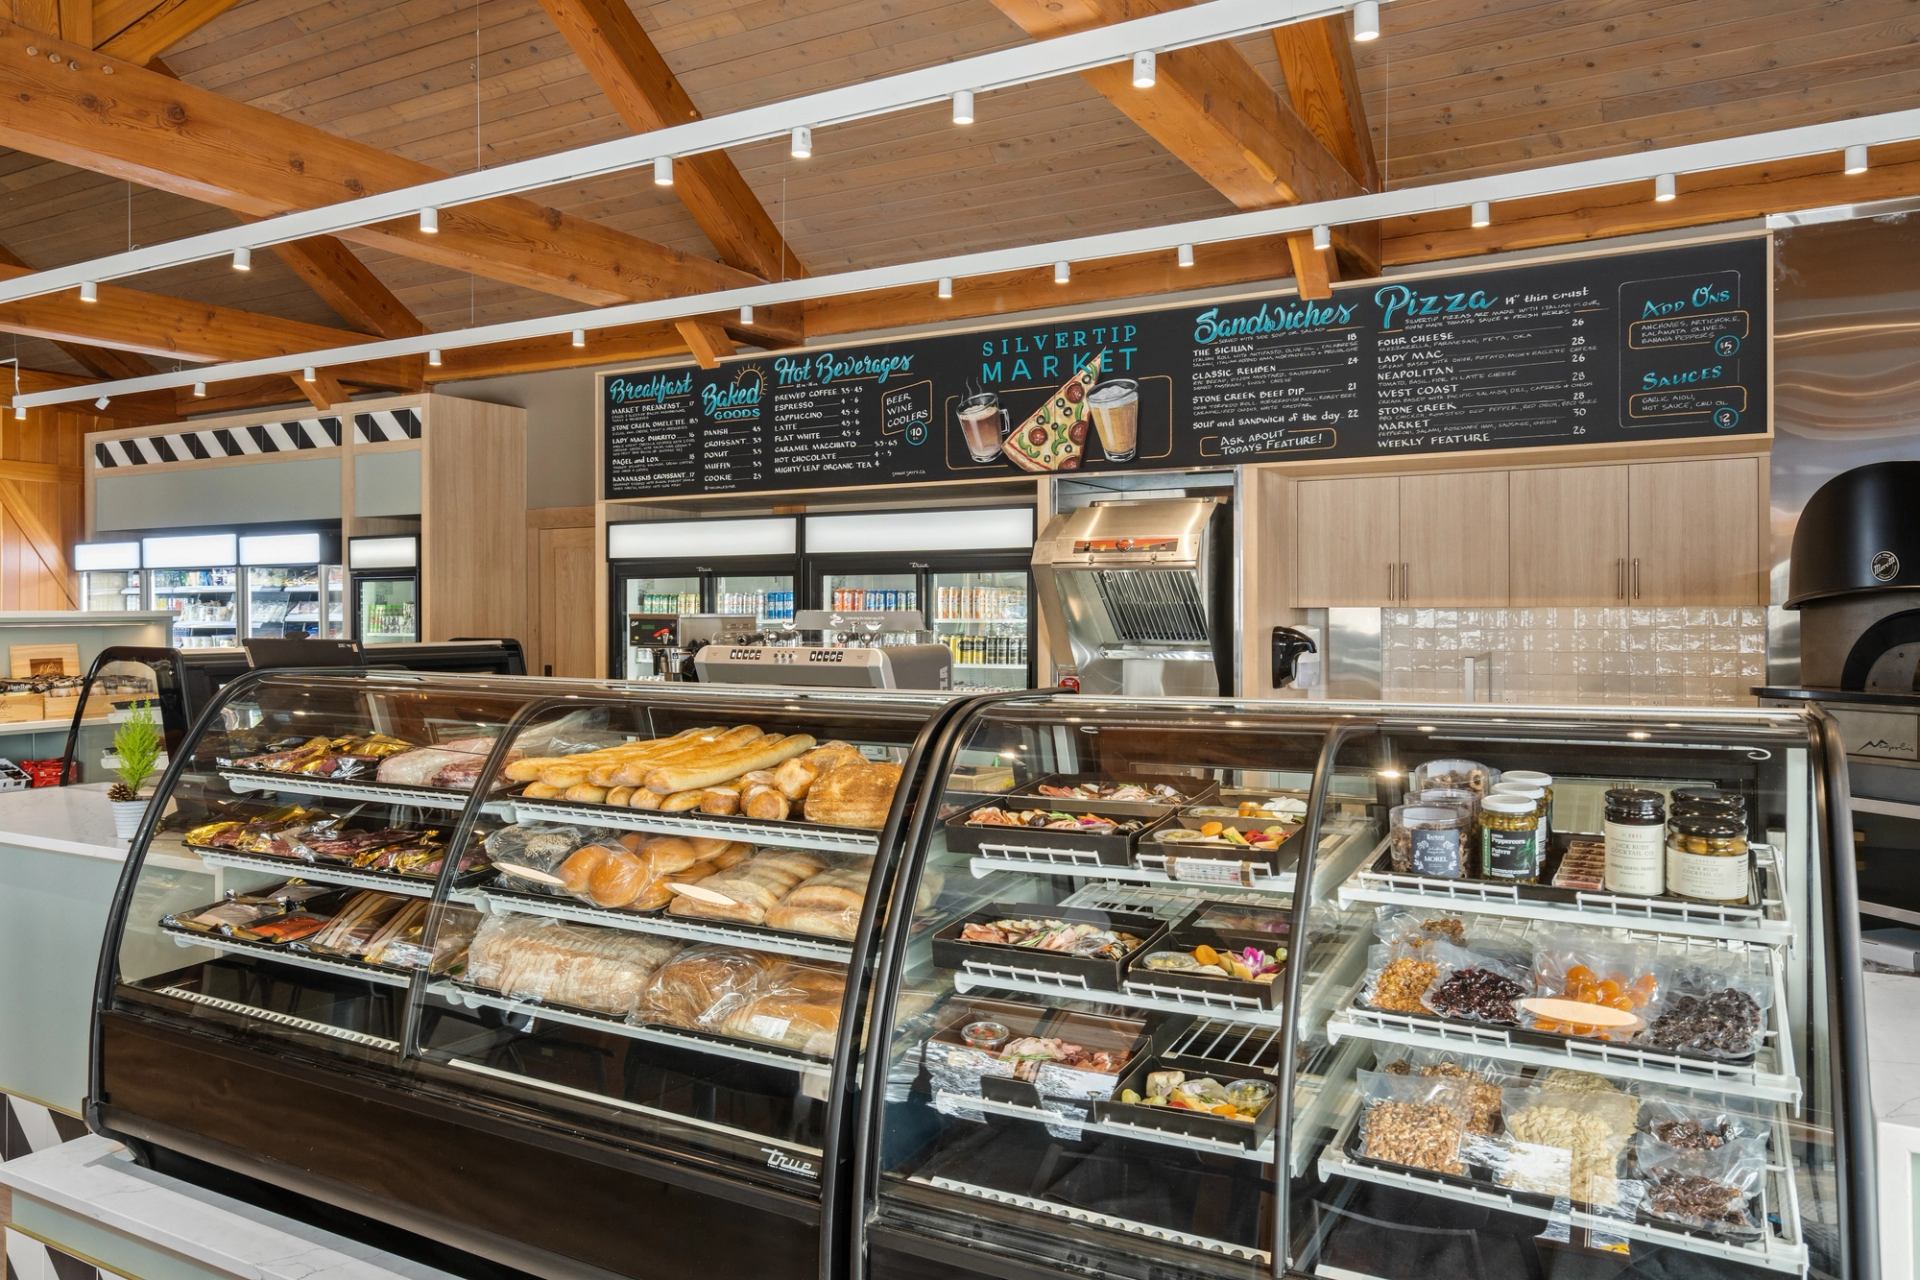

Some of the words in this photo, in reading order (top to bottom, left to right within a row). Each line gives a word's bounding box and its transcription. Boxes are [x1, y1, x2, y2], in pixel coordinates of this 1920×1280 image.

[1375, 285, 1499, 329] Pizza
[1524, 294, 1548, 303] thin
[1552, 286, 1589, 300] crust
[1194, 300, 1360, 344] Sandwiches
[1378, 337, 1407, 347] FOUR
[1410, 332, 1455, 343] CHEESE
[1571, 318, 1584, 326] 26
[1642, 336, 1673, 344] BANANA
[1675, 332, 1715, 340] PEPPERS
[982, 324, 1137, 357] SILVERTIP
[1192, 349, 1210, 357] THE
[1215, 344, 1254, 355] SICILIAN
[1347, 333, 1357, 341] 18
[1377, 352, 1408, 364] LADY
[1412, 350, 1444, 360] MAC
[1571, 336, 1585, 346] 28
[774, 357, 812, 384] Hot
[816, 352, 915, 384] Beverages
[982, 347, 1138, 384] MARKET
[1377, 366, 1454, 380] NEAPOLITAN
[1571, 353, 1586, 362] 26
[1192, 369, 1233, 380] CLASSIC
[1237, 365, 1276, 375] REUBEN
[610, 372, 692, 404] Breakfast
[1377, 388, 1413, 398] WEST
[1417, 384, 1459, 395] COAST
[1572, 372, 1585, 381] 28
[702, 378, 761, 416] Baked
[774, 392, 806, 402] BREWED
[809, 388, 838, 398] COFFEE
[886, 393, 911, 406] BEER
[1192, 395, 1221, 404] STONE
[1224, 392, 1256, 401] CREEK
[1260, 389, 1284, 398] BEEF
[1288, 387, 1305, 396] DIP
[1348, 382, 1357, 391] 21
[611, 405, 640, 415] MARKET
[641, 402, 680, 412] BREAKFAST
[774, 401, 814, 412] ESPRESSO
[887, 402, 913, 415] WINE
[1378, 405, 1413, 415] STONE
[1417, 402, 1456, 413] CREEK
[1573, 392, 1585, 400] 28
[714, 408, 761, 420] GOODS
[774, 412, 822, 422] CAPPUCCINO
[887, 410, 928, 428] COOLERS
[1217, 418, 1235, 427] and
[1239, 416, 1285, 425] SANDWICH
[1288, 412, 1298, 422] of
[1302, 413, 1317, 421] the
[1321, 411, 1340, 424] day
[1348, 409, 1359, 418] 22
[1378, 419, 1431, 431] MARKET
[1572, 408, 1586, 416] 30
[611, 424, 629, 432] STONE
[630, 422, 650, 430] CREEK
[704, 428, 729, 437] DANISH
[774, 423, 798, 432] LATTE
[612, 436, 628, 444] LADY
[648, 434, 676, 442] BURRITO
[774, 434, 794, 442] FLAT
[797, 432, 820, 441] WHITE
[1249, 429, 1286, 442] ABOUT
[1377, 436, 1425, 448] WEEKLY
[1431, 432, 1490, 444] FEATURE
[1573, 426, 1586, 434] 26
[704, 438, 746, 448] CROISSANT
[774, 444, 808, 453] CARAMEL
[812, 441, 857, 450] MACCHIATO
[1221, 443, 1262, 455] TODAYS
[1267, 433, 1322, 449] FEATURE!
[612, 458, 632, 466] BAGEL
[634, 456, 645, 464] and
[704, 450, 729, 459] DONUT
[774, 456, 788, 464] HOT
[792, 453, 837, 463] CHOCOLATE
[704, 462, 731, 470] MUFFIN
[774, 465, 801, 474] MIGHTY
[802, 464, 820, 472] LEAF
[823, 462, 854, 471] ORGANIC
[856, 461, 872, 469] TEA
[612, 474, 652, 482] KANANASKIS
[653, 472, 686, 480] CROISSANT
[704, 474, 732, 482] COOKIE
